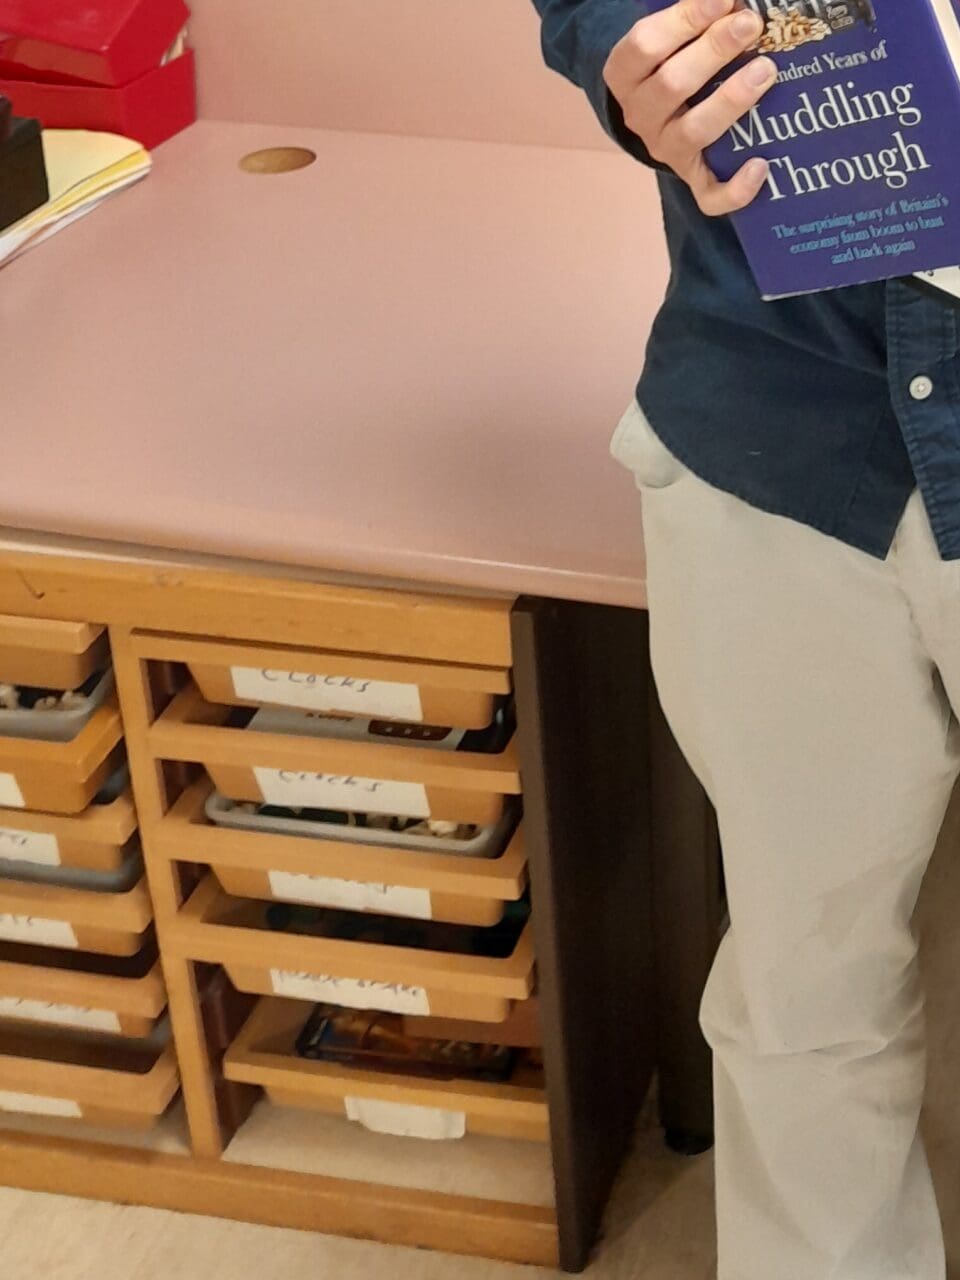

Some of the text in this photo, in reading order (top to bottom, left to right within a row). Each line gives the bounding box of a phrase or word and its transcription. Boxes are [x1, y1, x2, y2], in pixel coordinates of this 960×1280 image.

[776, 39, 888, 83] ndred Years of
[729, 81, 922, 152] Muddling
[766, 131, 932, 201] Through
[771, 224, 798, 239] The
[798, 212, 855, 234] surprising
[854, 207, 883, 223] story
[885, 201, 898, 216] of
[790, 235, 840, 254] economy
[840, 228, 870, 244] from
[869, 222, 905, 238] boom
[904, 218, 919, 232] to
[831, 237, 916, 265] and back again
